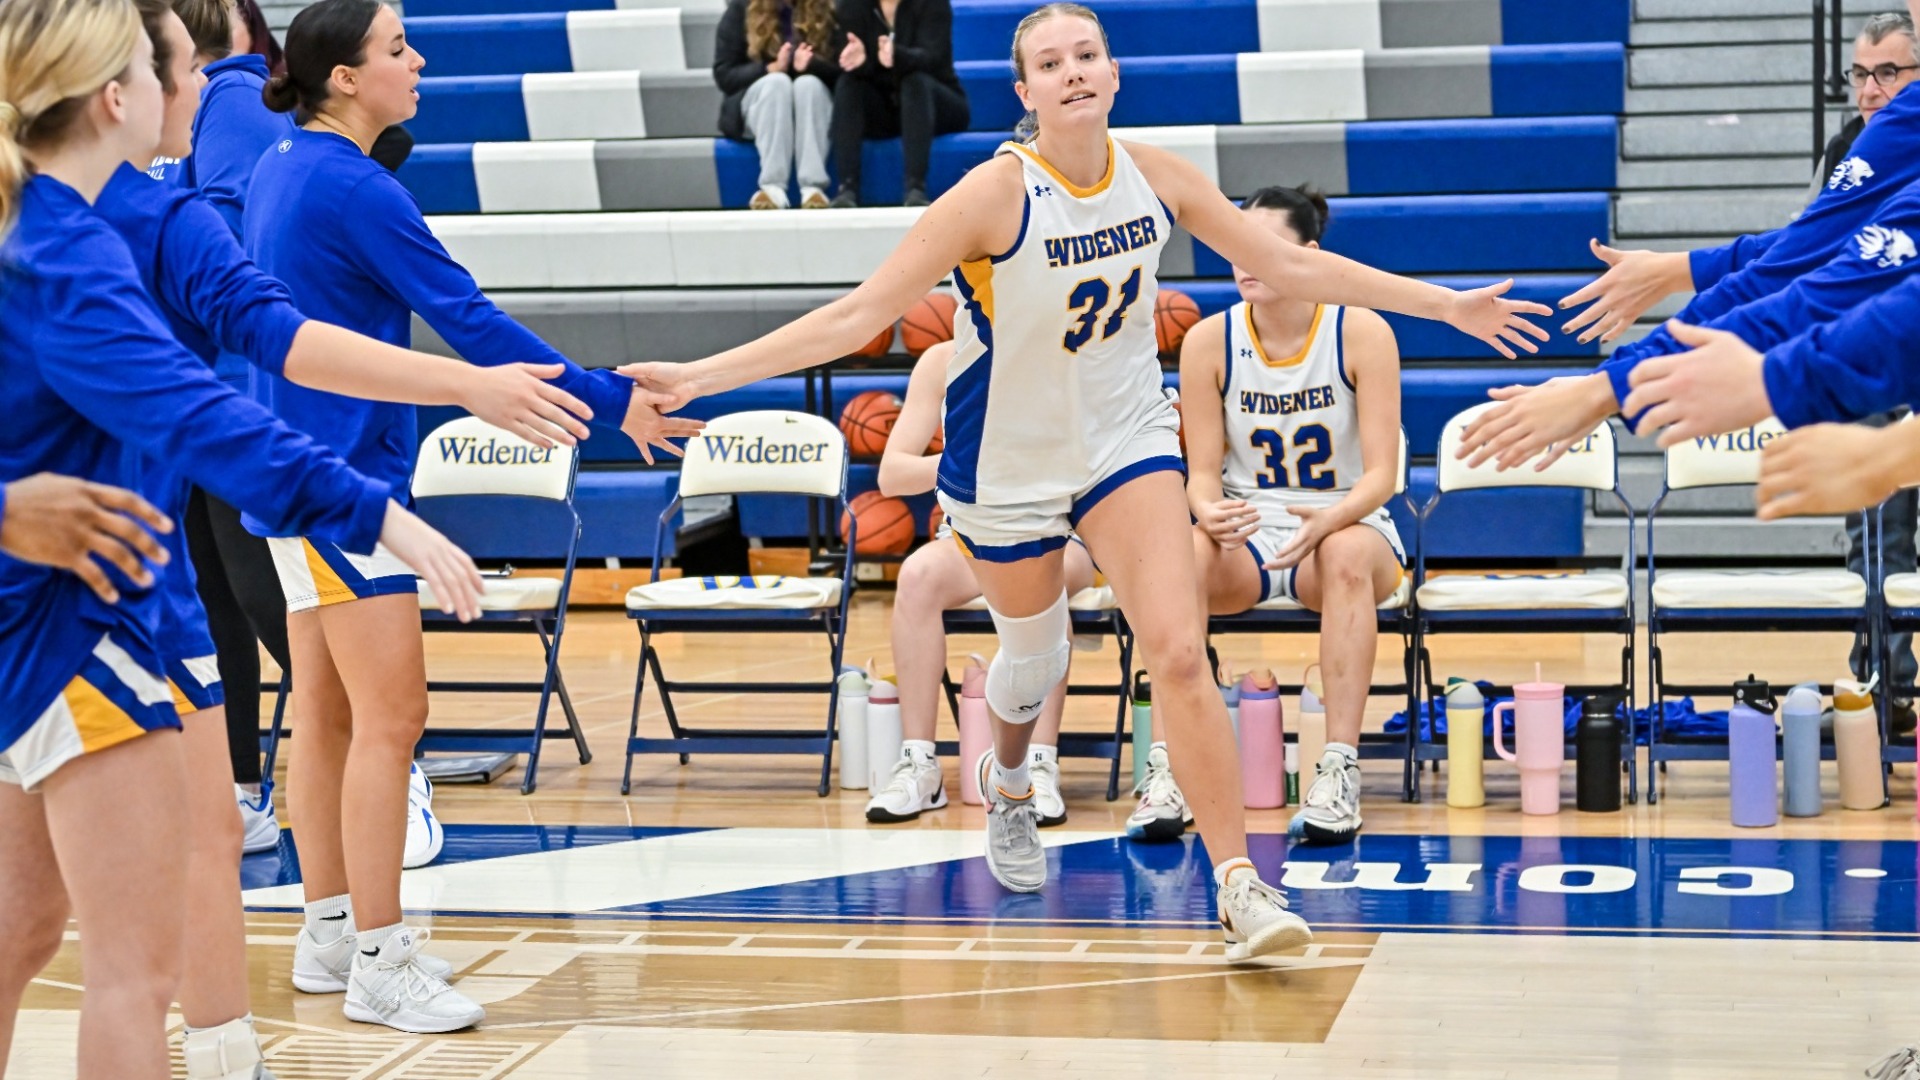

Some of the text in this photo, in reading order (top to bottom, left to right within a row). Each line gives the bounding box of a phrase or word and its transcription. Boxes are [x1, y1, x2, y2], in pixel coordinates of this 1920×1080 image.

[1043, 215, 1158, 268] WIDENER
[1062, 264, 1142, 355] 31
[1240, 384, 1336, 415] WIDENER
[437, 436, 559, 465] Widener
[702, 435, 829, 464] Widener
[1694, 425, 1788, 452] Wide
[1249, 422, 1337, 491] 32
